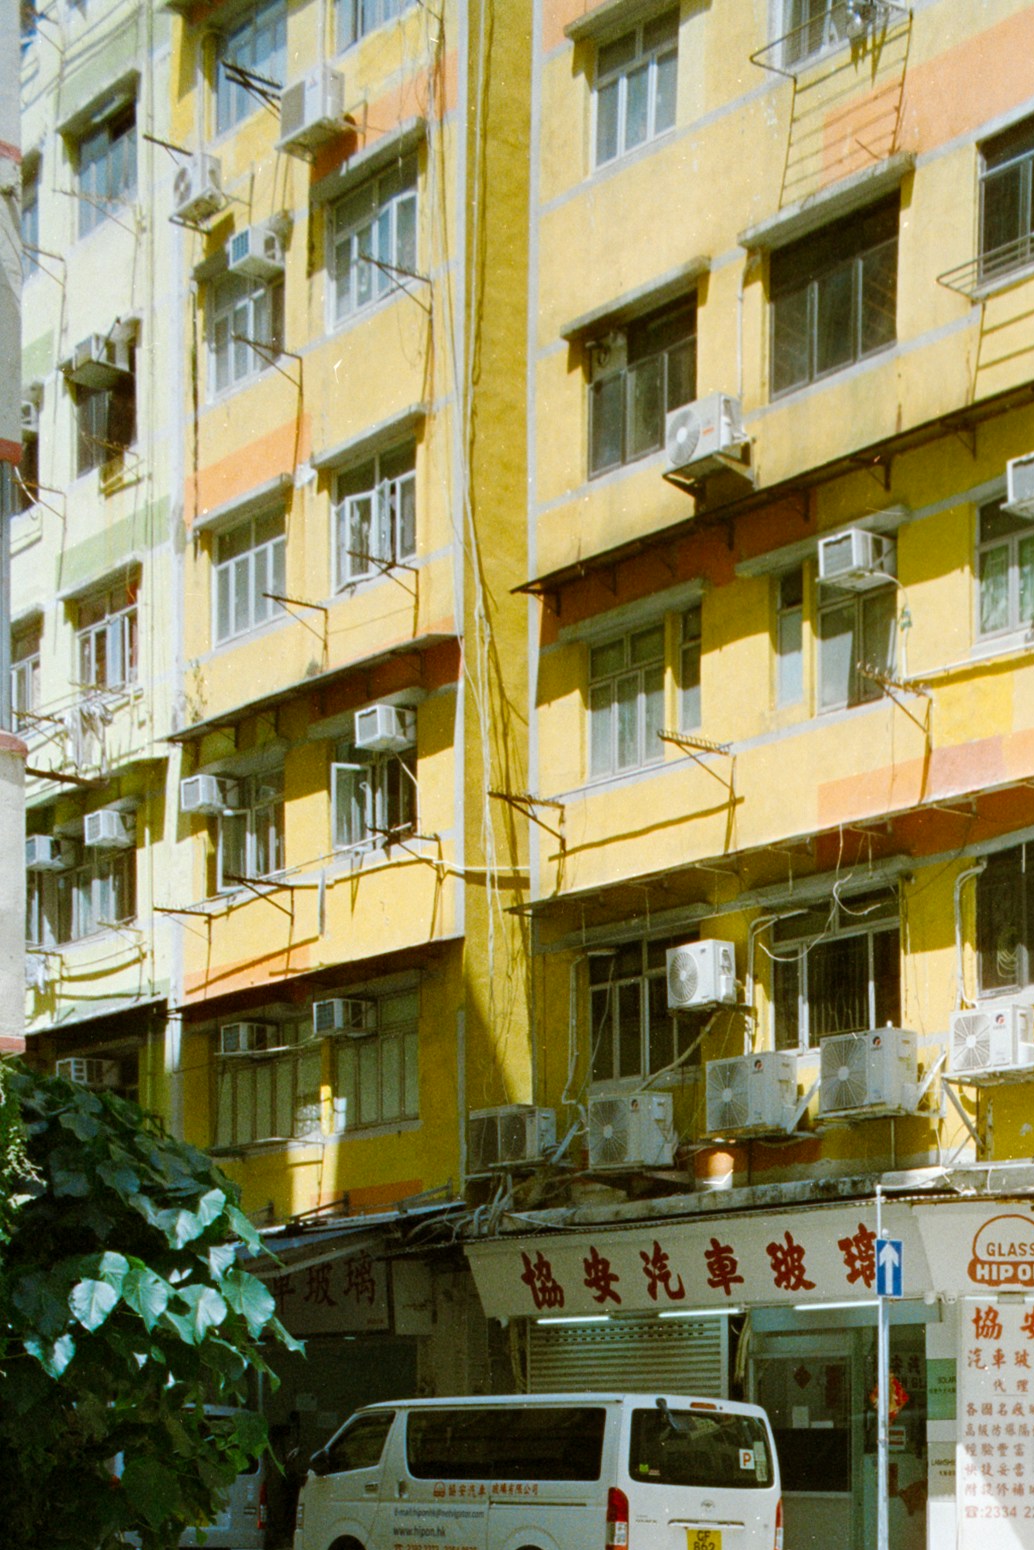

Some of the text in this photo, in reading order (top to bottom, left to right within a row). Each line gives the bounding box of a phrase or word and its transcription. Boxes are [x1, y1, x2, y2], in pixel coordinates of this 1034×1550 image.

[520, 1222, 877, 1310] 協安汽車玻璃
[976, 1263, 1014, 1281] HIP
[993, 1379, 1029, 1393] 代理
[743, 1452, 752, 1467] P
